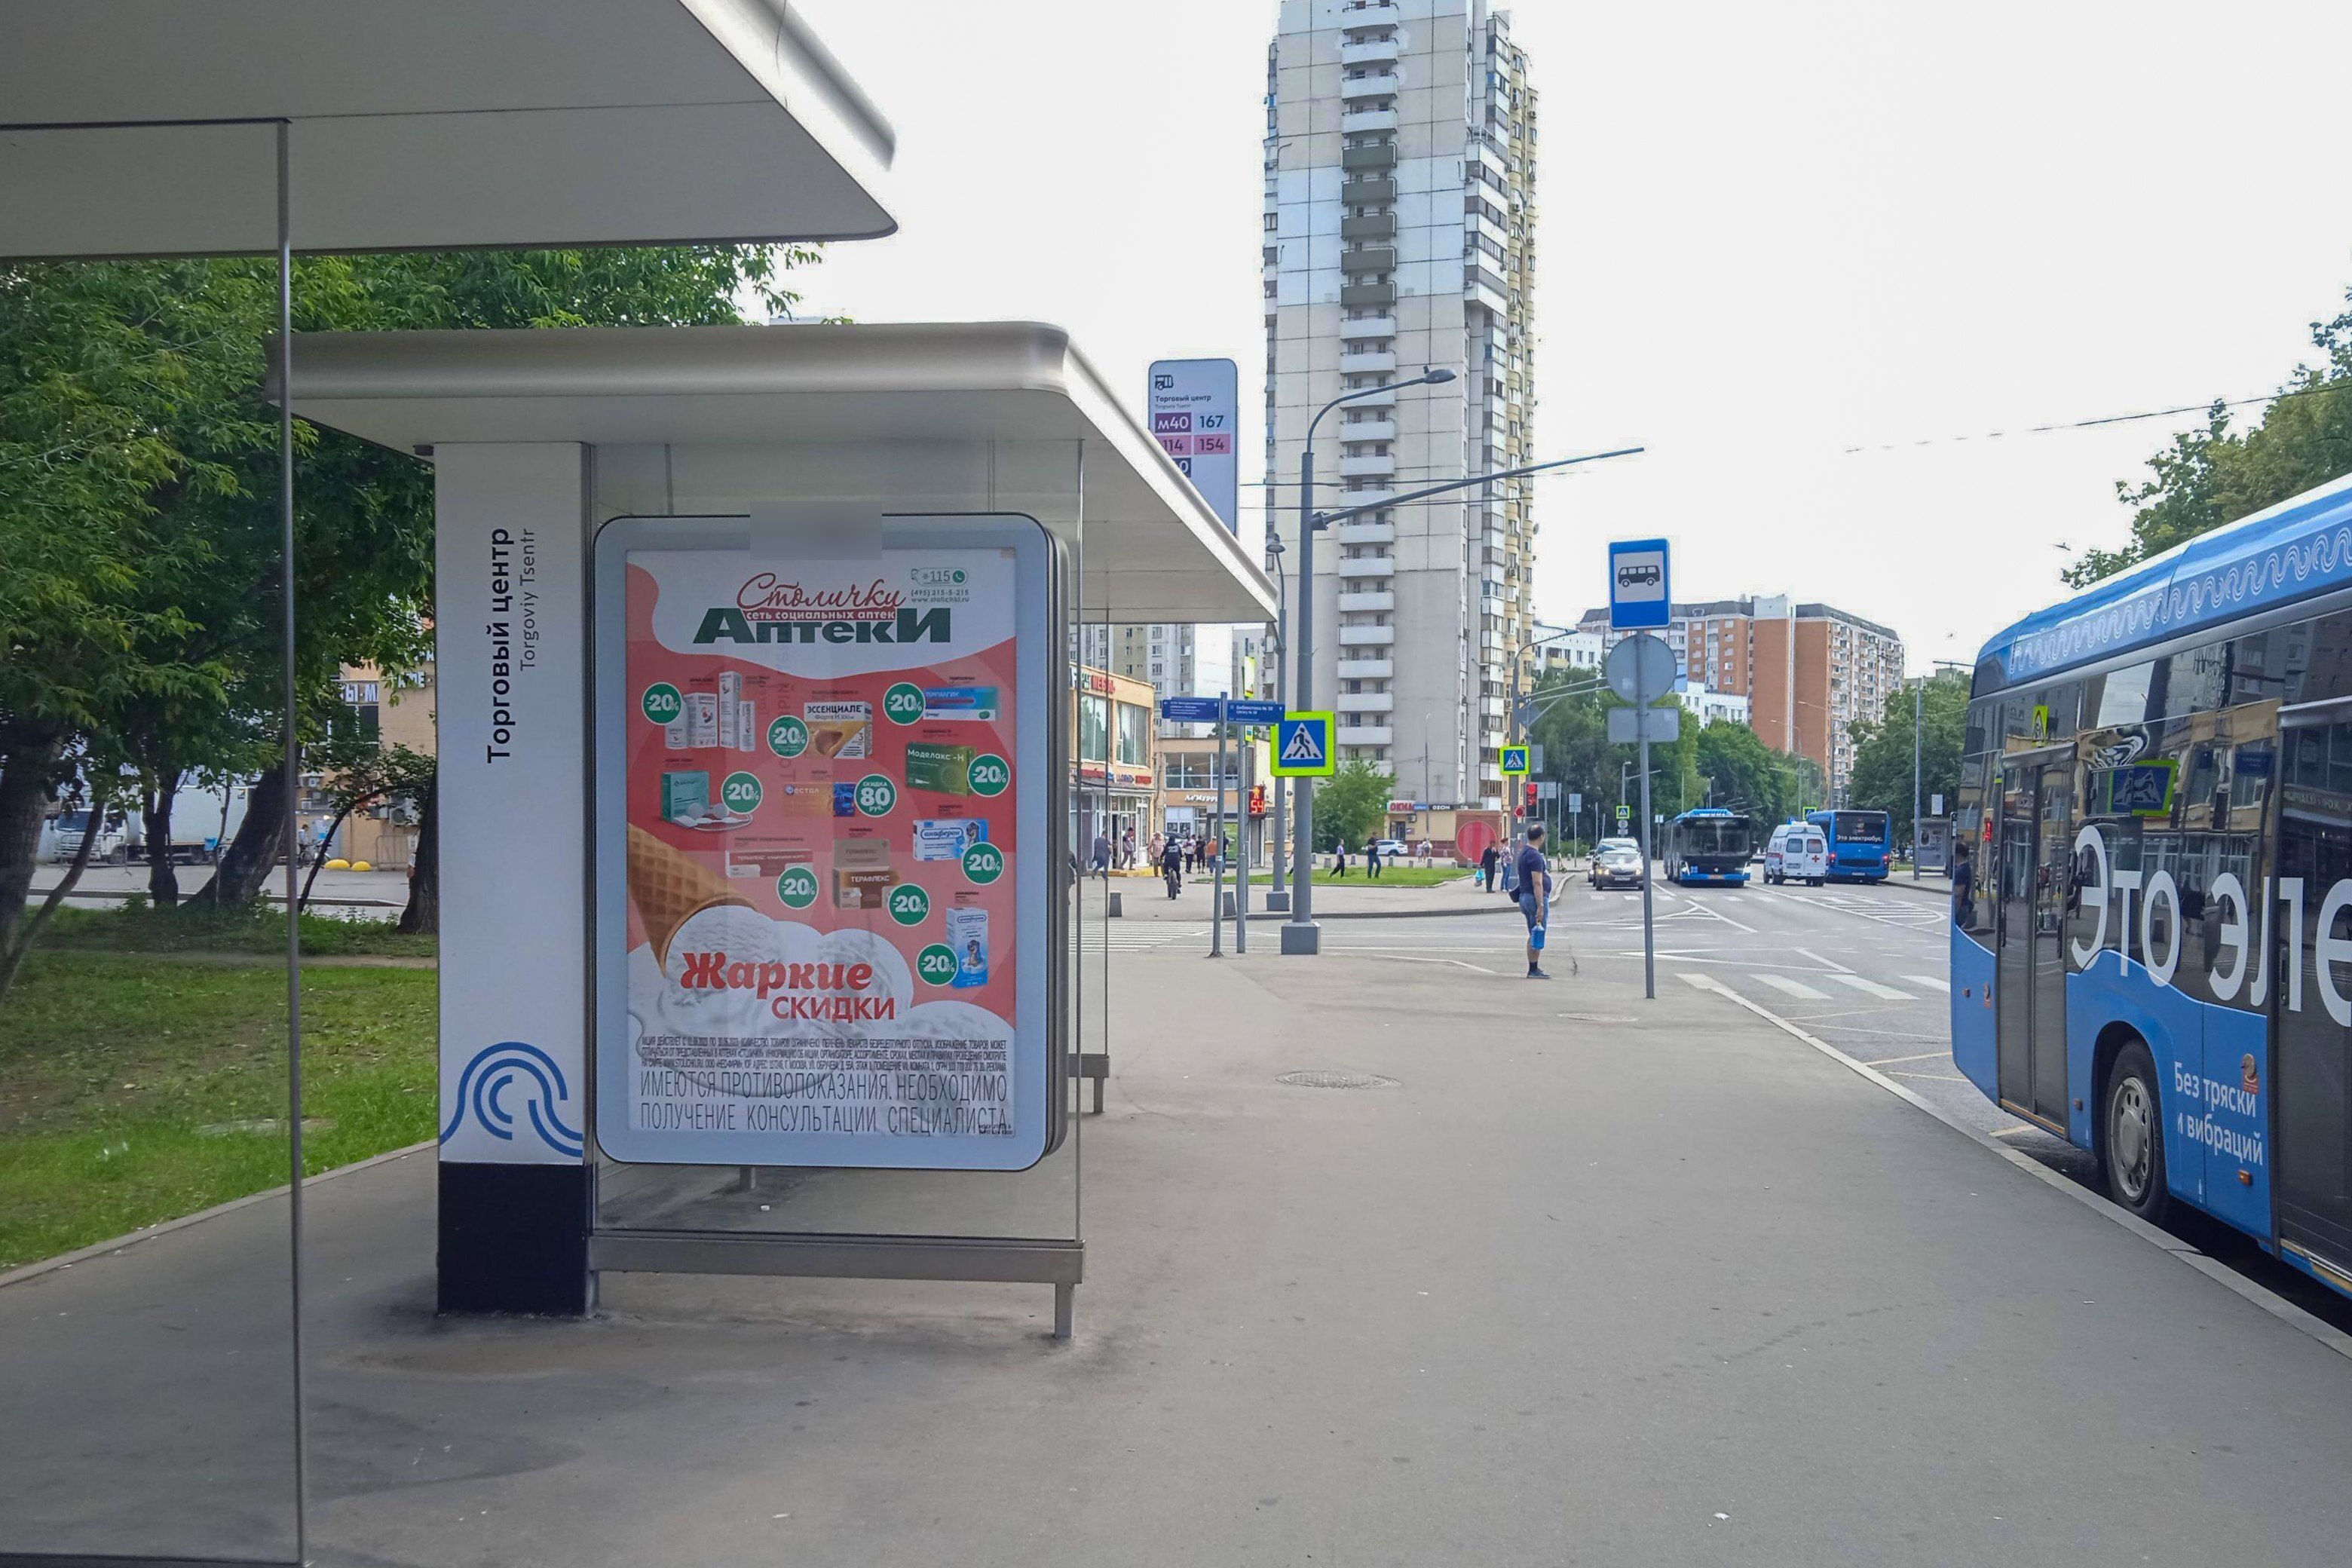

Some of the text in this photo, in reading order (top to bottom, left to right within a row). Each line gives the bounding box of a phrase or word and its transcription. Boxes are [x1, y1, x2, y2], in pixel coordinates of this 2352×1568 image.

[1199, 415, 1224, 428] 167
[1163, 438, 1225, 452] 114 154
[520, 528, 539, 671] Torgoviy Tsentr
[737, 572, 906, 610] Столички
[911, 589, 930, 597] (495)
[746, 610, 896, 620] сеть социальных аптек
[486, 528, 516, 764] Торговый центр
[647, 694, 679, 712] -20%
[807, 706, 862, 714] ЭССЕНЦИАЛЕ
[889, 694, 923, 712] -20%
[772, 727, 806, 745] -20%
[907, 749, 951, 761] Моделакс
[972, 765, 1006, 783] -20%
[726, 783, 760, 801] -20%
[859, 788, 891, 806] 80
[1251, 800, 1264, 813] 54
[1389, 802, 1413, 811] ОКНА
[966, 853, 1001, 872] -20%
[782, 877, 816, 896] -20%
[893, 895, 927, 914] -20%
[2070, 825, 2352, 1027] Это эле
[920, 954, 955, 973] -20%
[680, 952, 873, 1000] Жаркие
[641, 1070, 1007, 1104] ИМЕЮТСЯ ПРОТИВОПОКАЗАНИЯ. НЕОБХОДИМО
[2174, 1061, 2256, 1118] Без тряски
[641, 1103, 1006, 1136] ПОЛУЧЕНИЕ КОНСУЛЬТАЦИИ СПЕЦИАЛИСТА
[2187, 1113, 2263, 1166] вибраций
